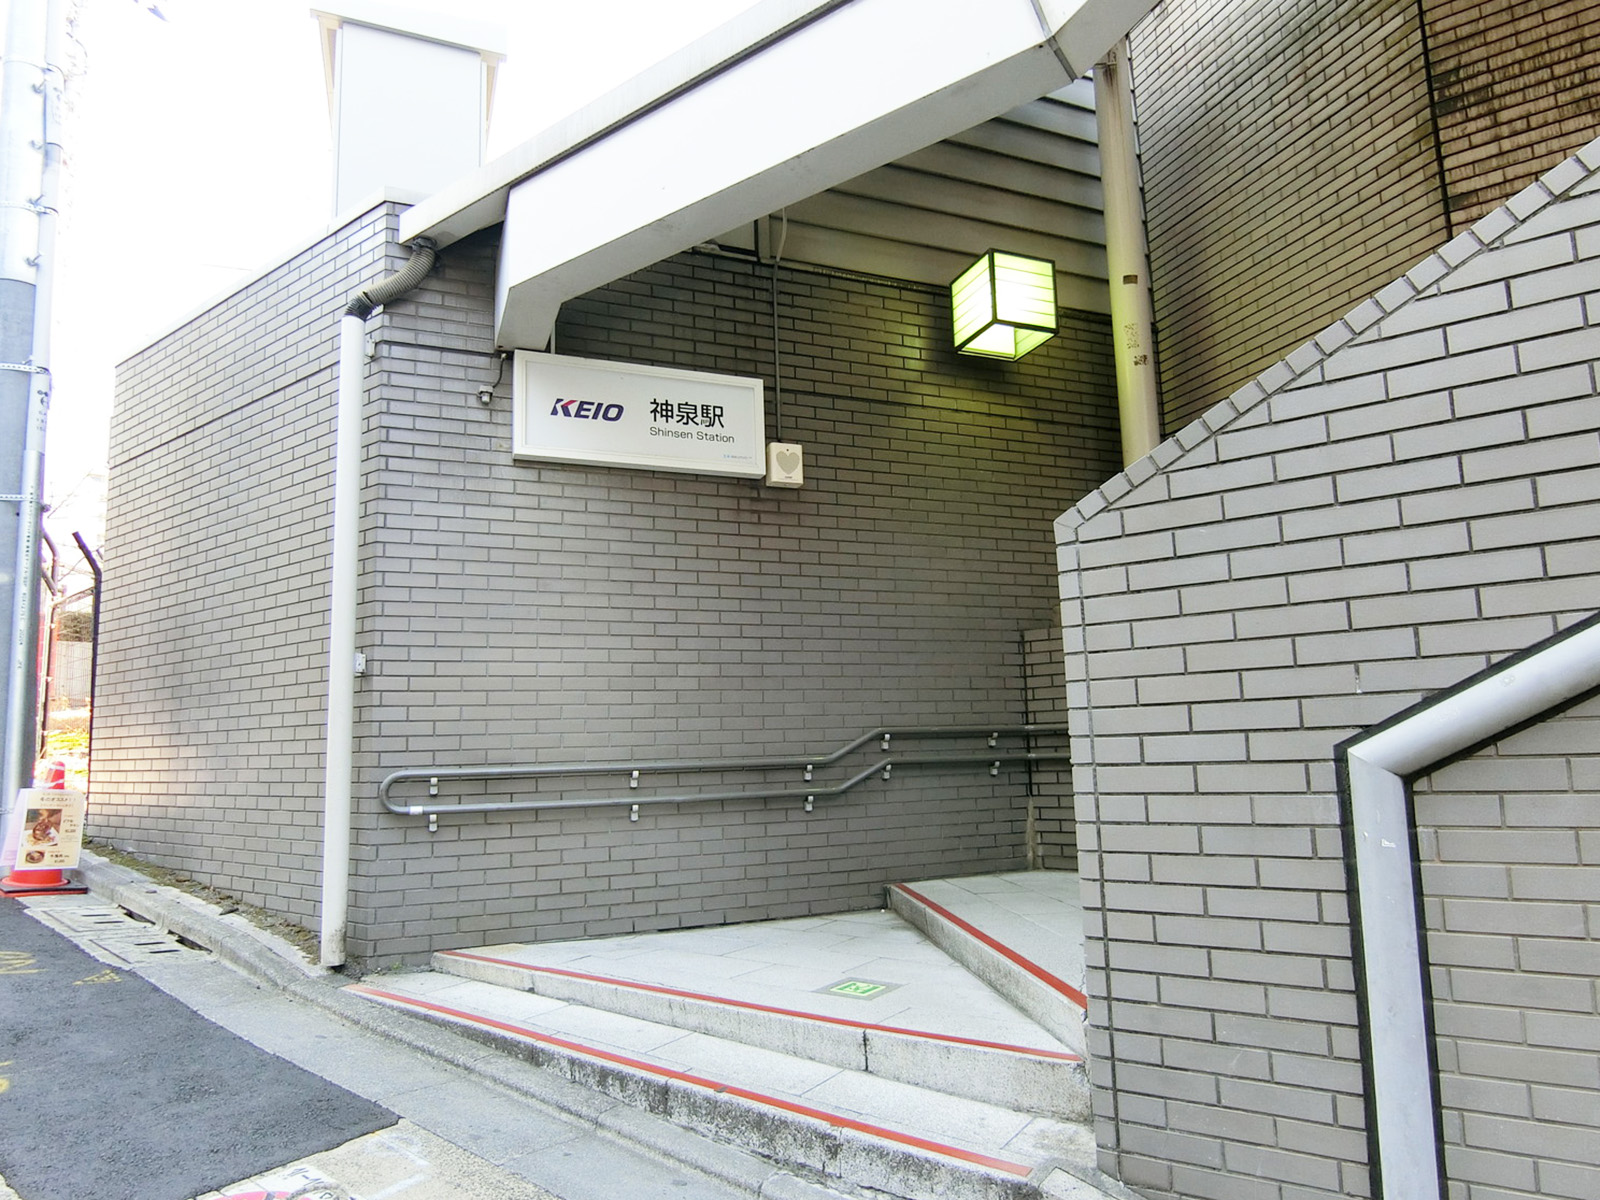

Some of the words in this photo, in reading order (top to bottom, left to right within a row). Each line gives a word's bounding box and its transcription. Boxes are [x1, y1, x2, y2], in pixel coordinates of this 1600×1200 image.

[550, 398, 624, 422] KEIO
[649, 397, 725, 429] 神泉駅
[649, 426, 693, 440] Shinsen
[697, 431, 735, 444] Station
